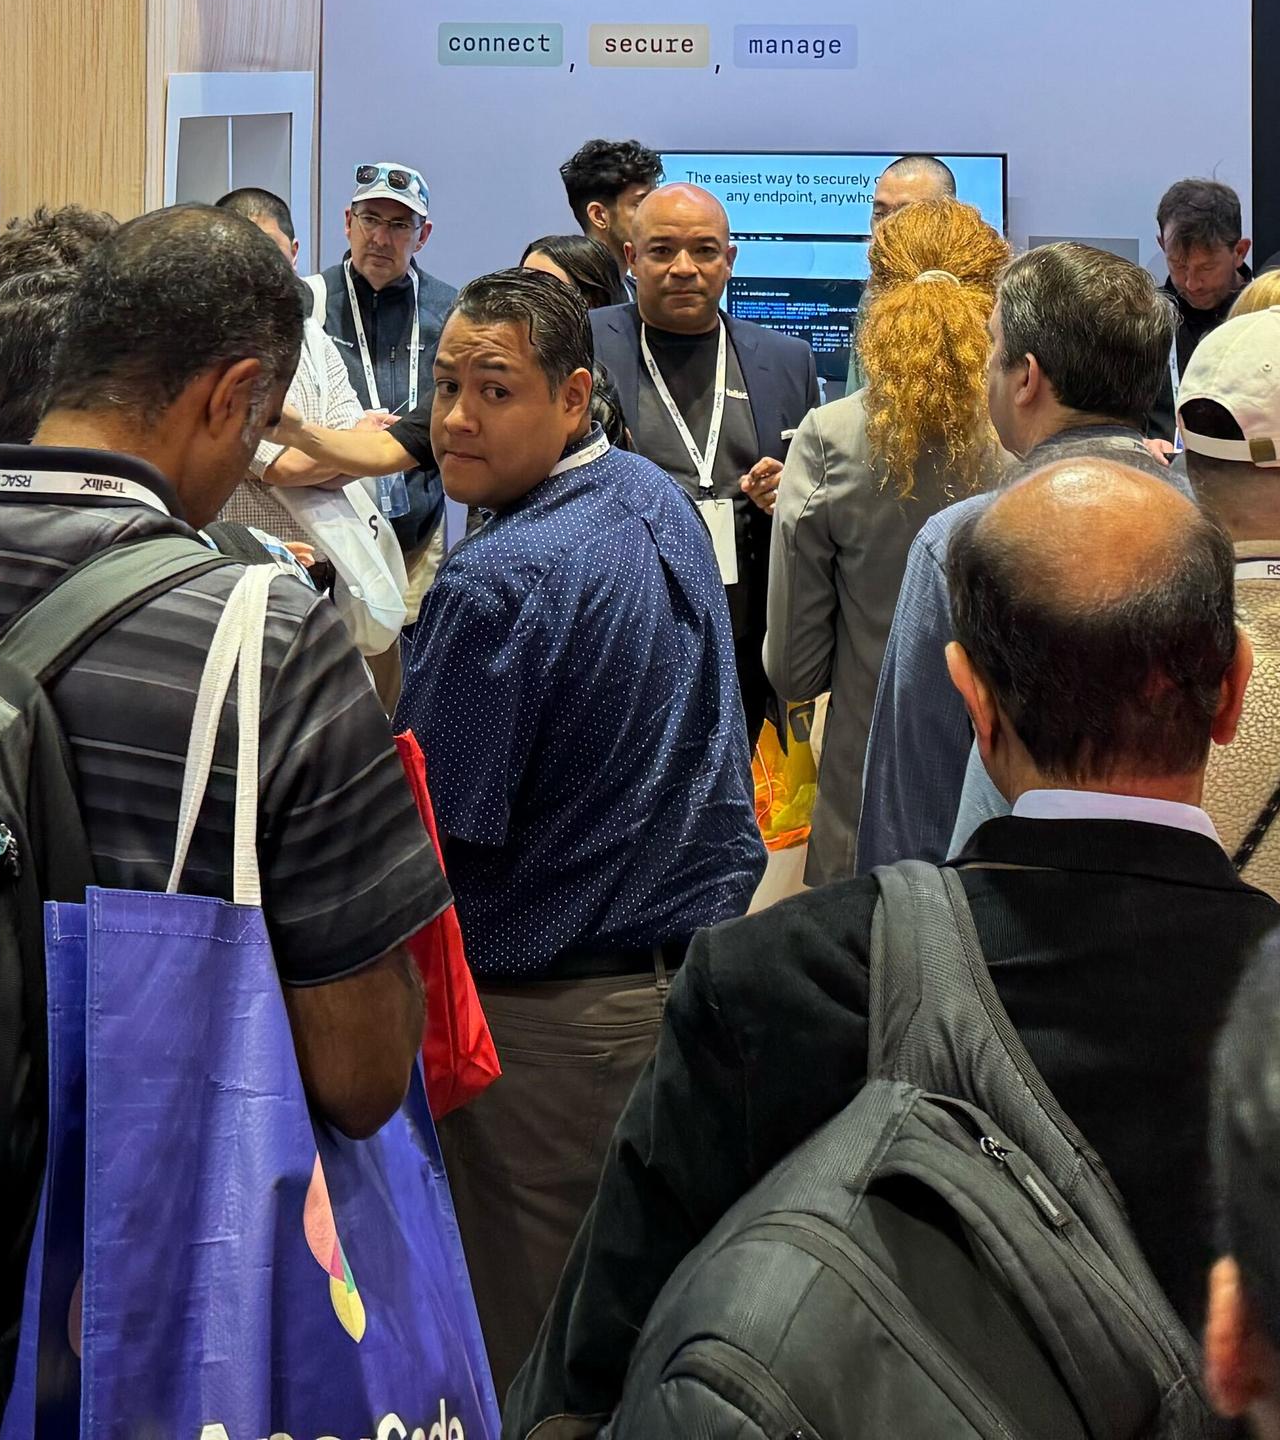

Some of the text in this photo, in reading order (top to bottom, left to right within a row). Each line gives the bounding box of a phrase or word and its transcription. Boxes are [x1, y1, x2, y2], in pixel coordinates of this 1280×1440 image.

[748, 36, 842, 59] manage
[686, 171, 712, 184] The
[714, 172, 762, 185] easiest
[764, 174, 793, 187] way
[794, 173, 810, 185] to
[813, 172, 870, 187] securely
[726, 191, 874, 205] any endpoint, anywhe
[0, 474, 33, 488] RSAC
[80, 477, 126, 494] Trellix
